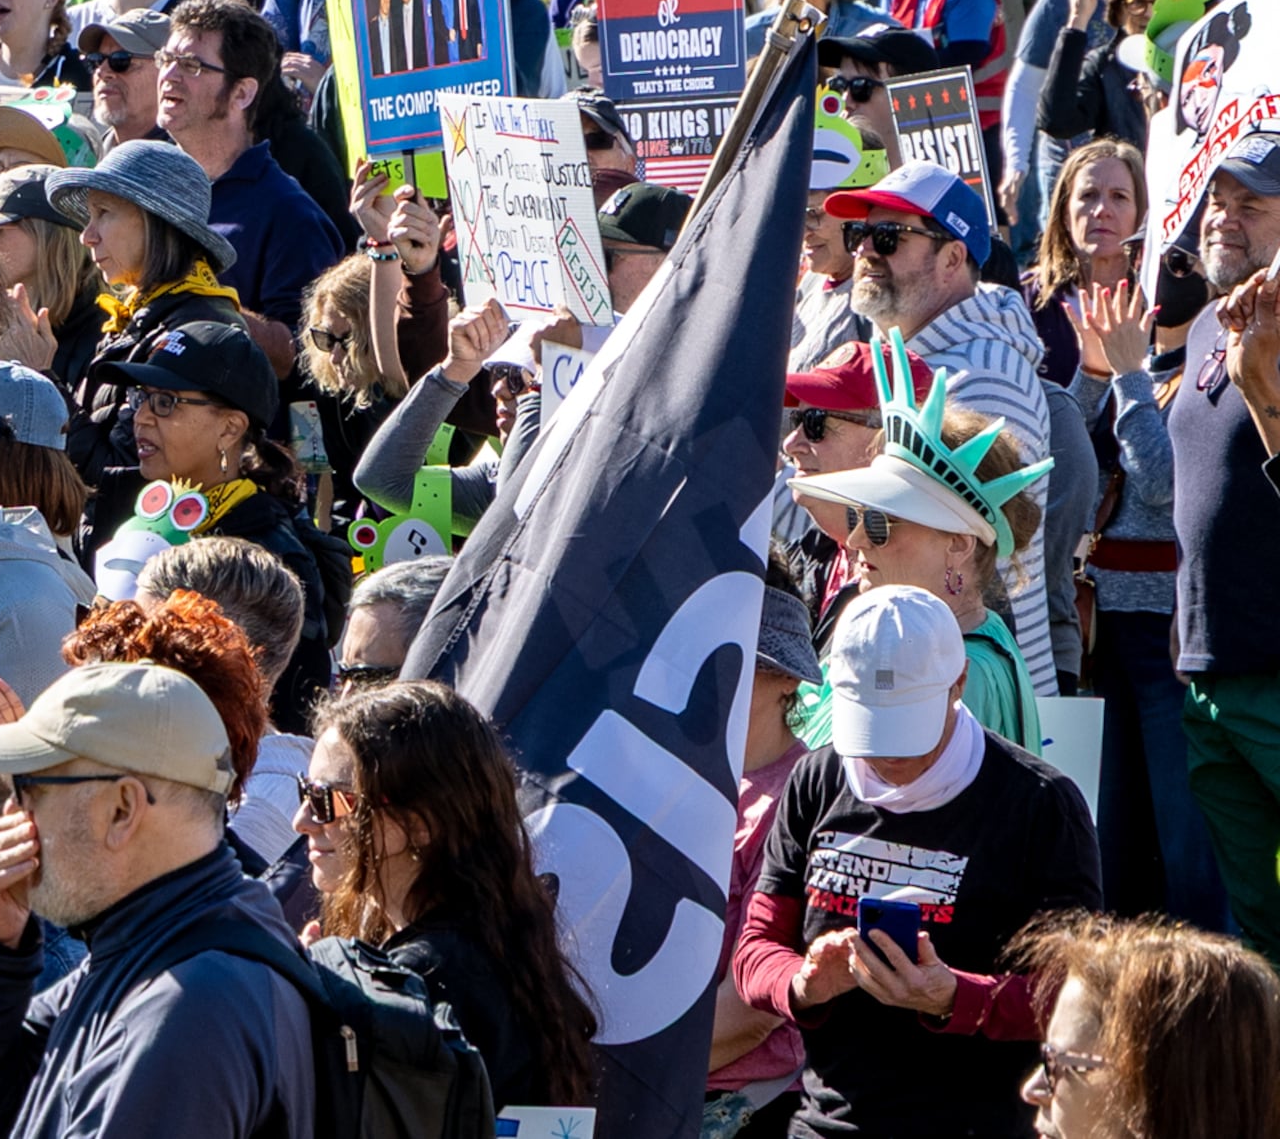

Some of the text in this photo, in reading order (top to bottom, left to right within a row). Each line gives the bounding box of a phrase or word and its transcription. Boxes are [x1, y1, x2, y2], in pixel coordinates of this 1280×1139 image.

[619, 27, 723, 62] DEMOCRACY
[633, 76, 716, 95] THAT'S THE CHOICE
[370, 95, 394, 122] THE
[472, 102, 556, 142] IF WE THE PEOPLE
[648, 107, 708, 140] KINGS
[637, 137, 713, 159] SINCE 1776
[900, 123, 980, 176] RESIST!
[540, 153, 592, 188] JUSTICE
[497, 251, 555, 308] PEACE
[560, 225, 609, 317] RESIST
[812, 849, 890, 882] STAND
